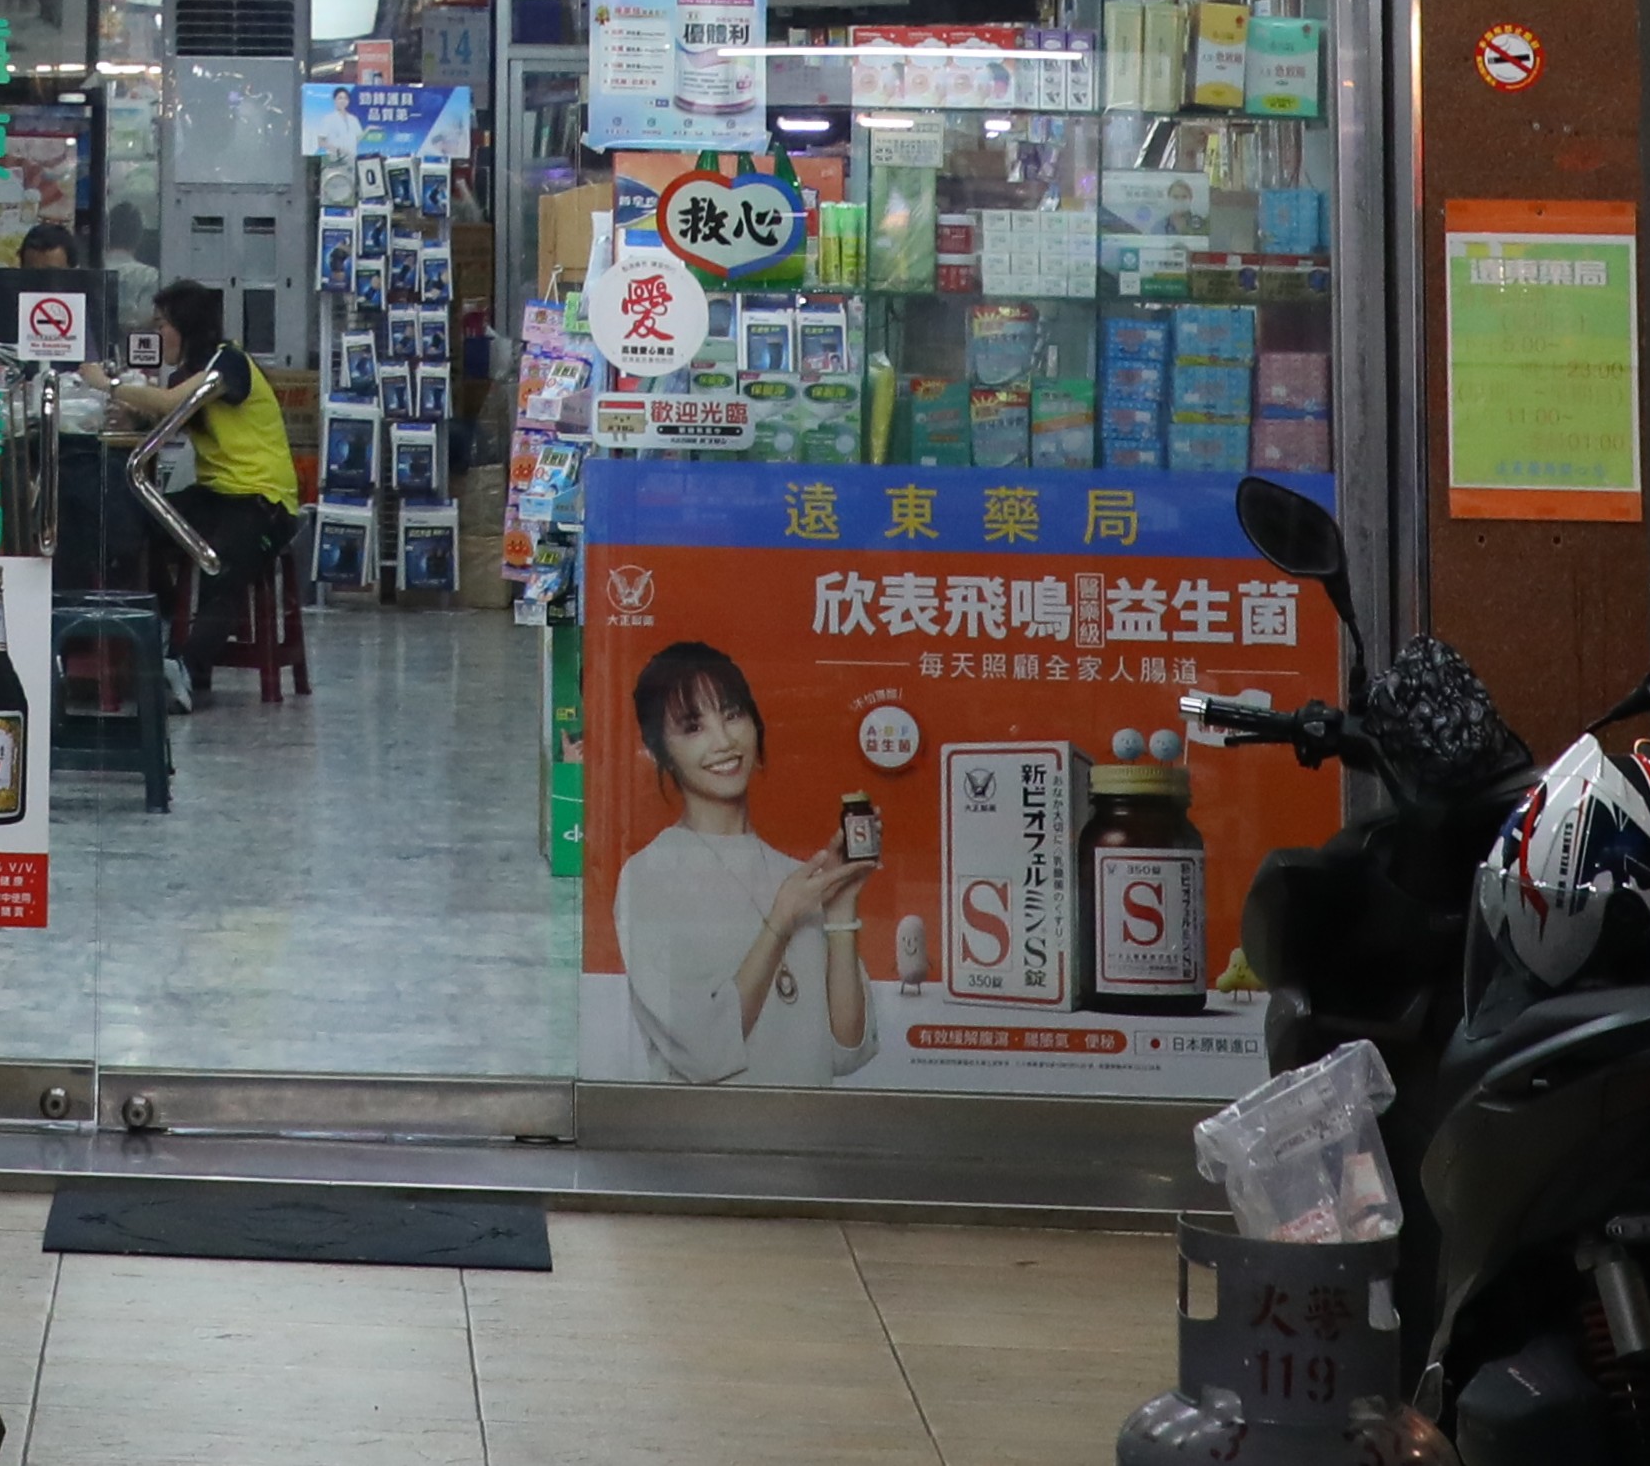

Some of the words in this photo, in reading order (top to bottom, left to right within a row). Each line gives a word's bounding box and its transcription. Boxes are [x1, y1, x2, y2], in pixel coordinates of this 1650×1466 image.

[439, 29, 473, 65] 14
[677, 196, 783, 248] 救心
[650, 400, 749, 425] 歡迎光臨
[783, 481, 1142, 546] 遠東藥局
[812, 570, 1072, 644] 欣表飛鳴
[1105, 578, 1301, 647] 益生菌
[918, 652, 1200, 686] 每天照顧全家人腸道
[960, 879, 1012, 969] S
[1122, 880, 1166, 947] S
[1172, 1036, 1260, 1054] 日本原裝進口
[1255, 1349, 1338, 1404] 119
